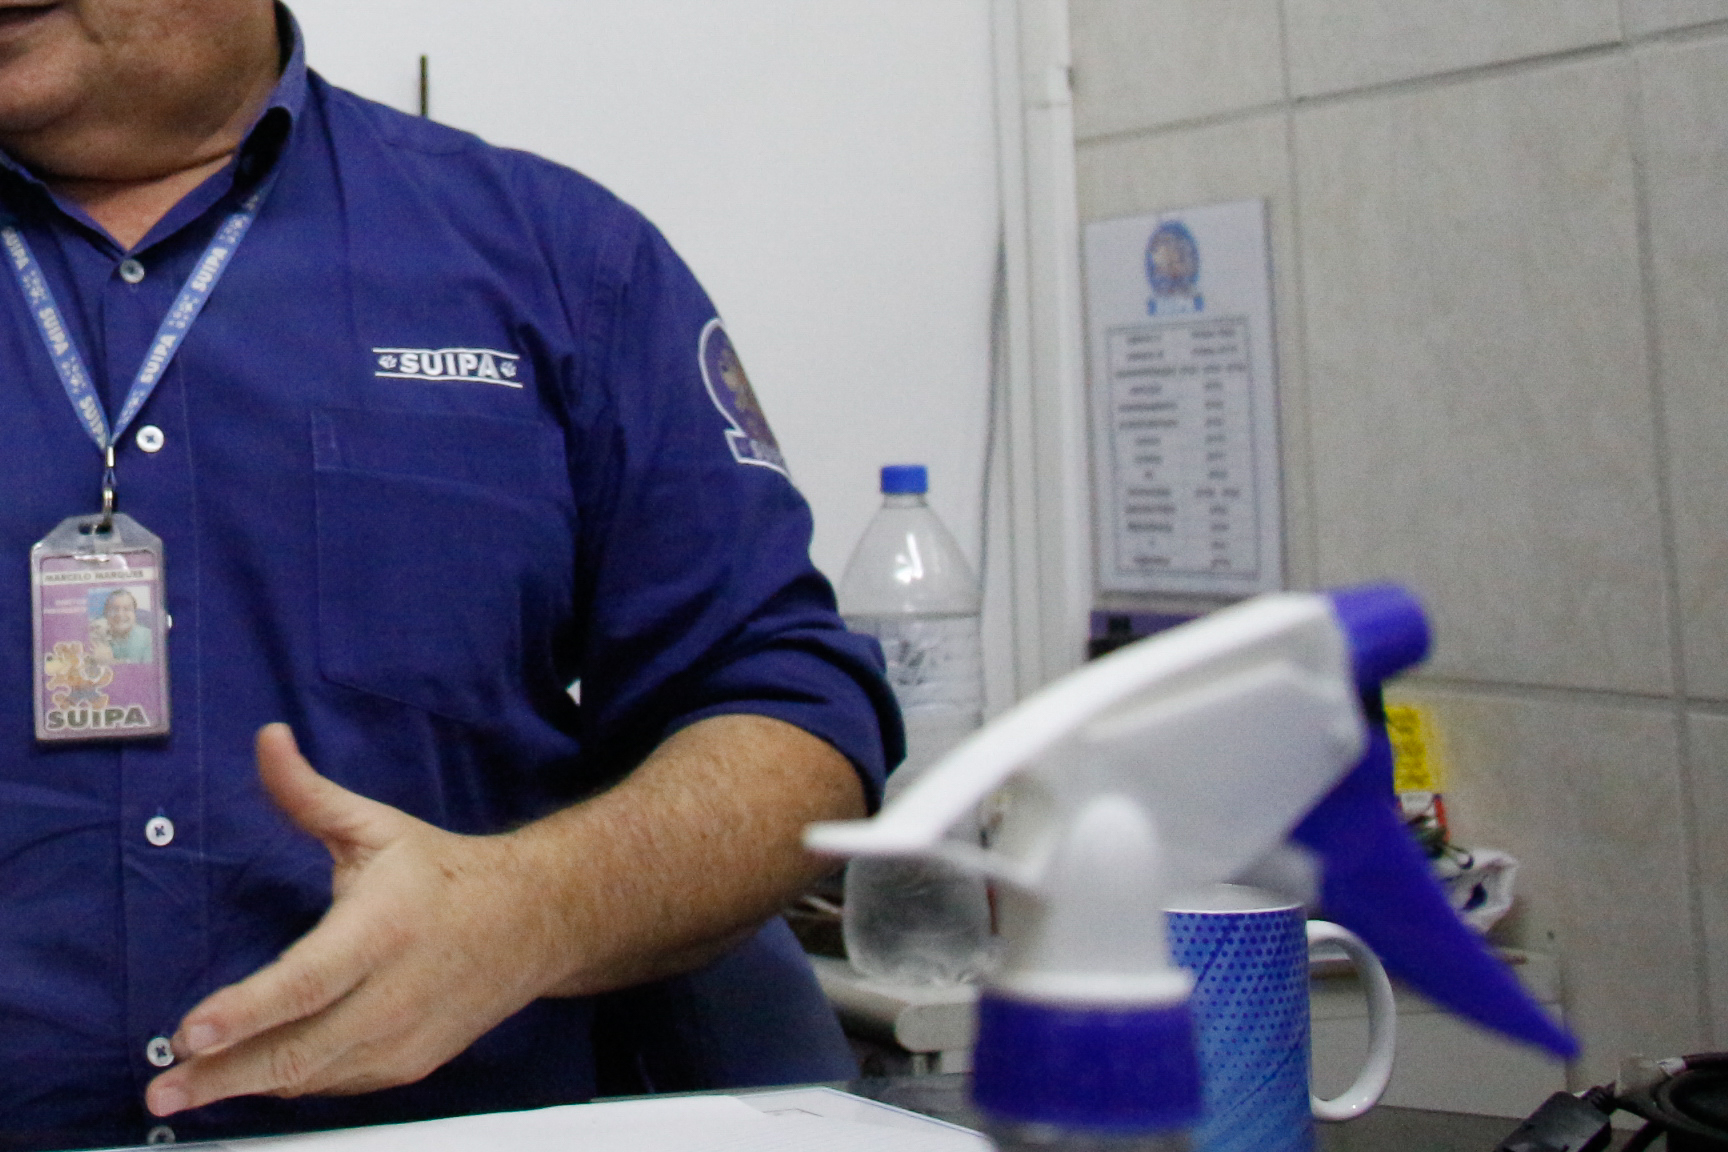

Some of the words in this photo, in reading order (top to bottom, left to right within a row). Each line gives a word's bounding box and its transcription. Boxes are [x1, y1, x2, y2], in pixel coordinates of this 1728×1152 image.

[191, 246, 228, 292] SUIPA
[38, 307, 69, 355] SUIPA
[139, 334, 177, 383] SUIPA
[399, 352, 501, 380] SUIPA
[46, 705, 149, 730] SUIPA
